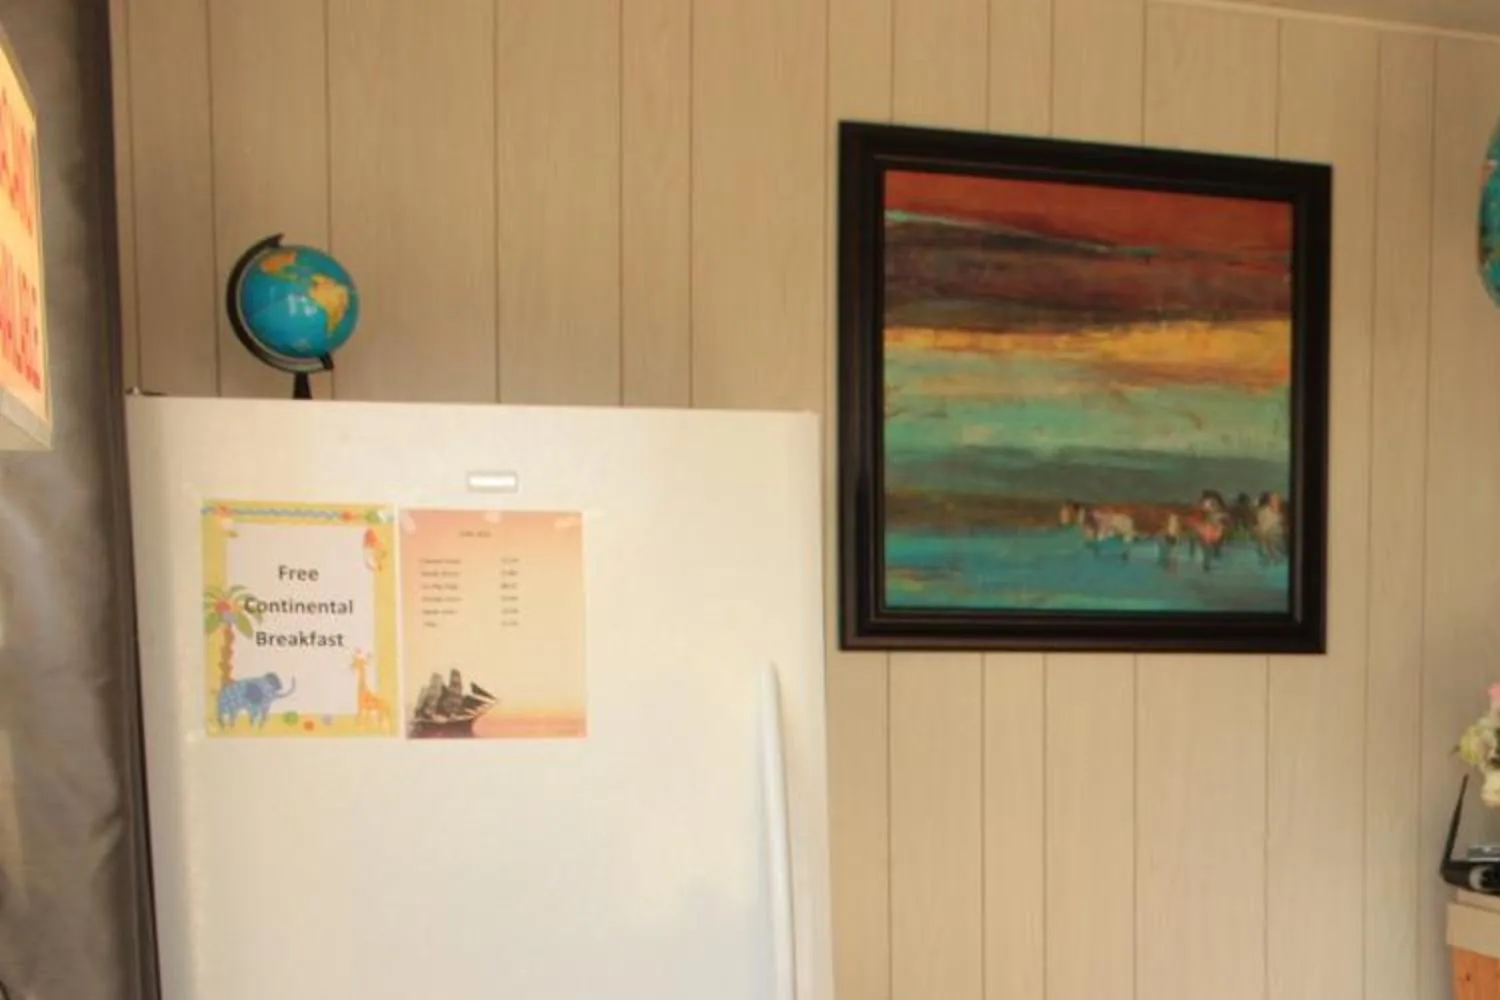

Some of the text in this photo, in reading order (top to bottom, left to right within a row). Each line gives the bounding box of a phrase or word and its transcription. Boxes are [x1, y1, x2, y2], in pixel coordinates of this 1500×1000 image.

[278, 565, 319, 581] Free
[244, 597, 353, 615] Continental
[256, 631, 344, 647] Breakfast
